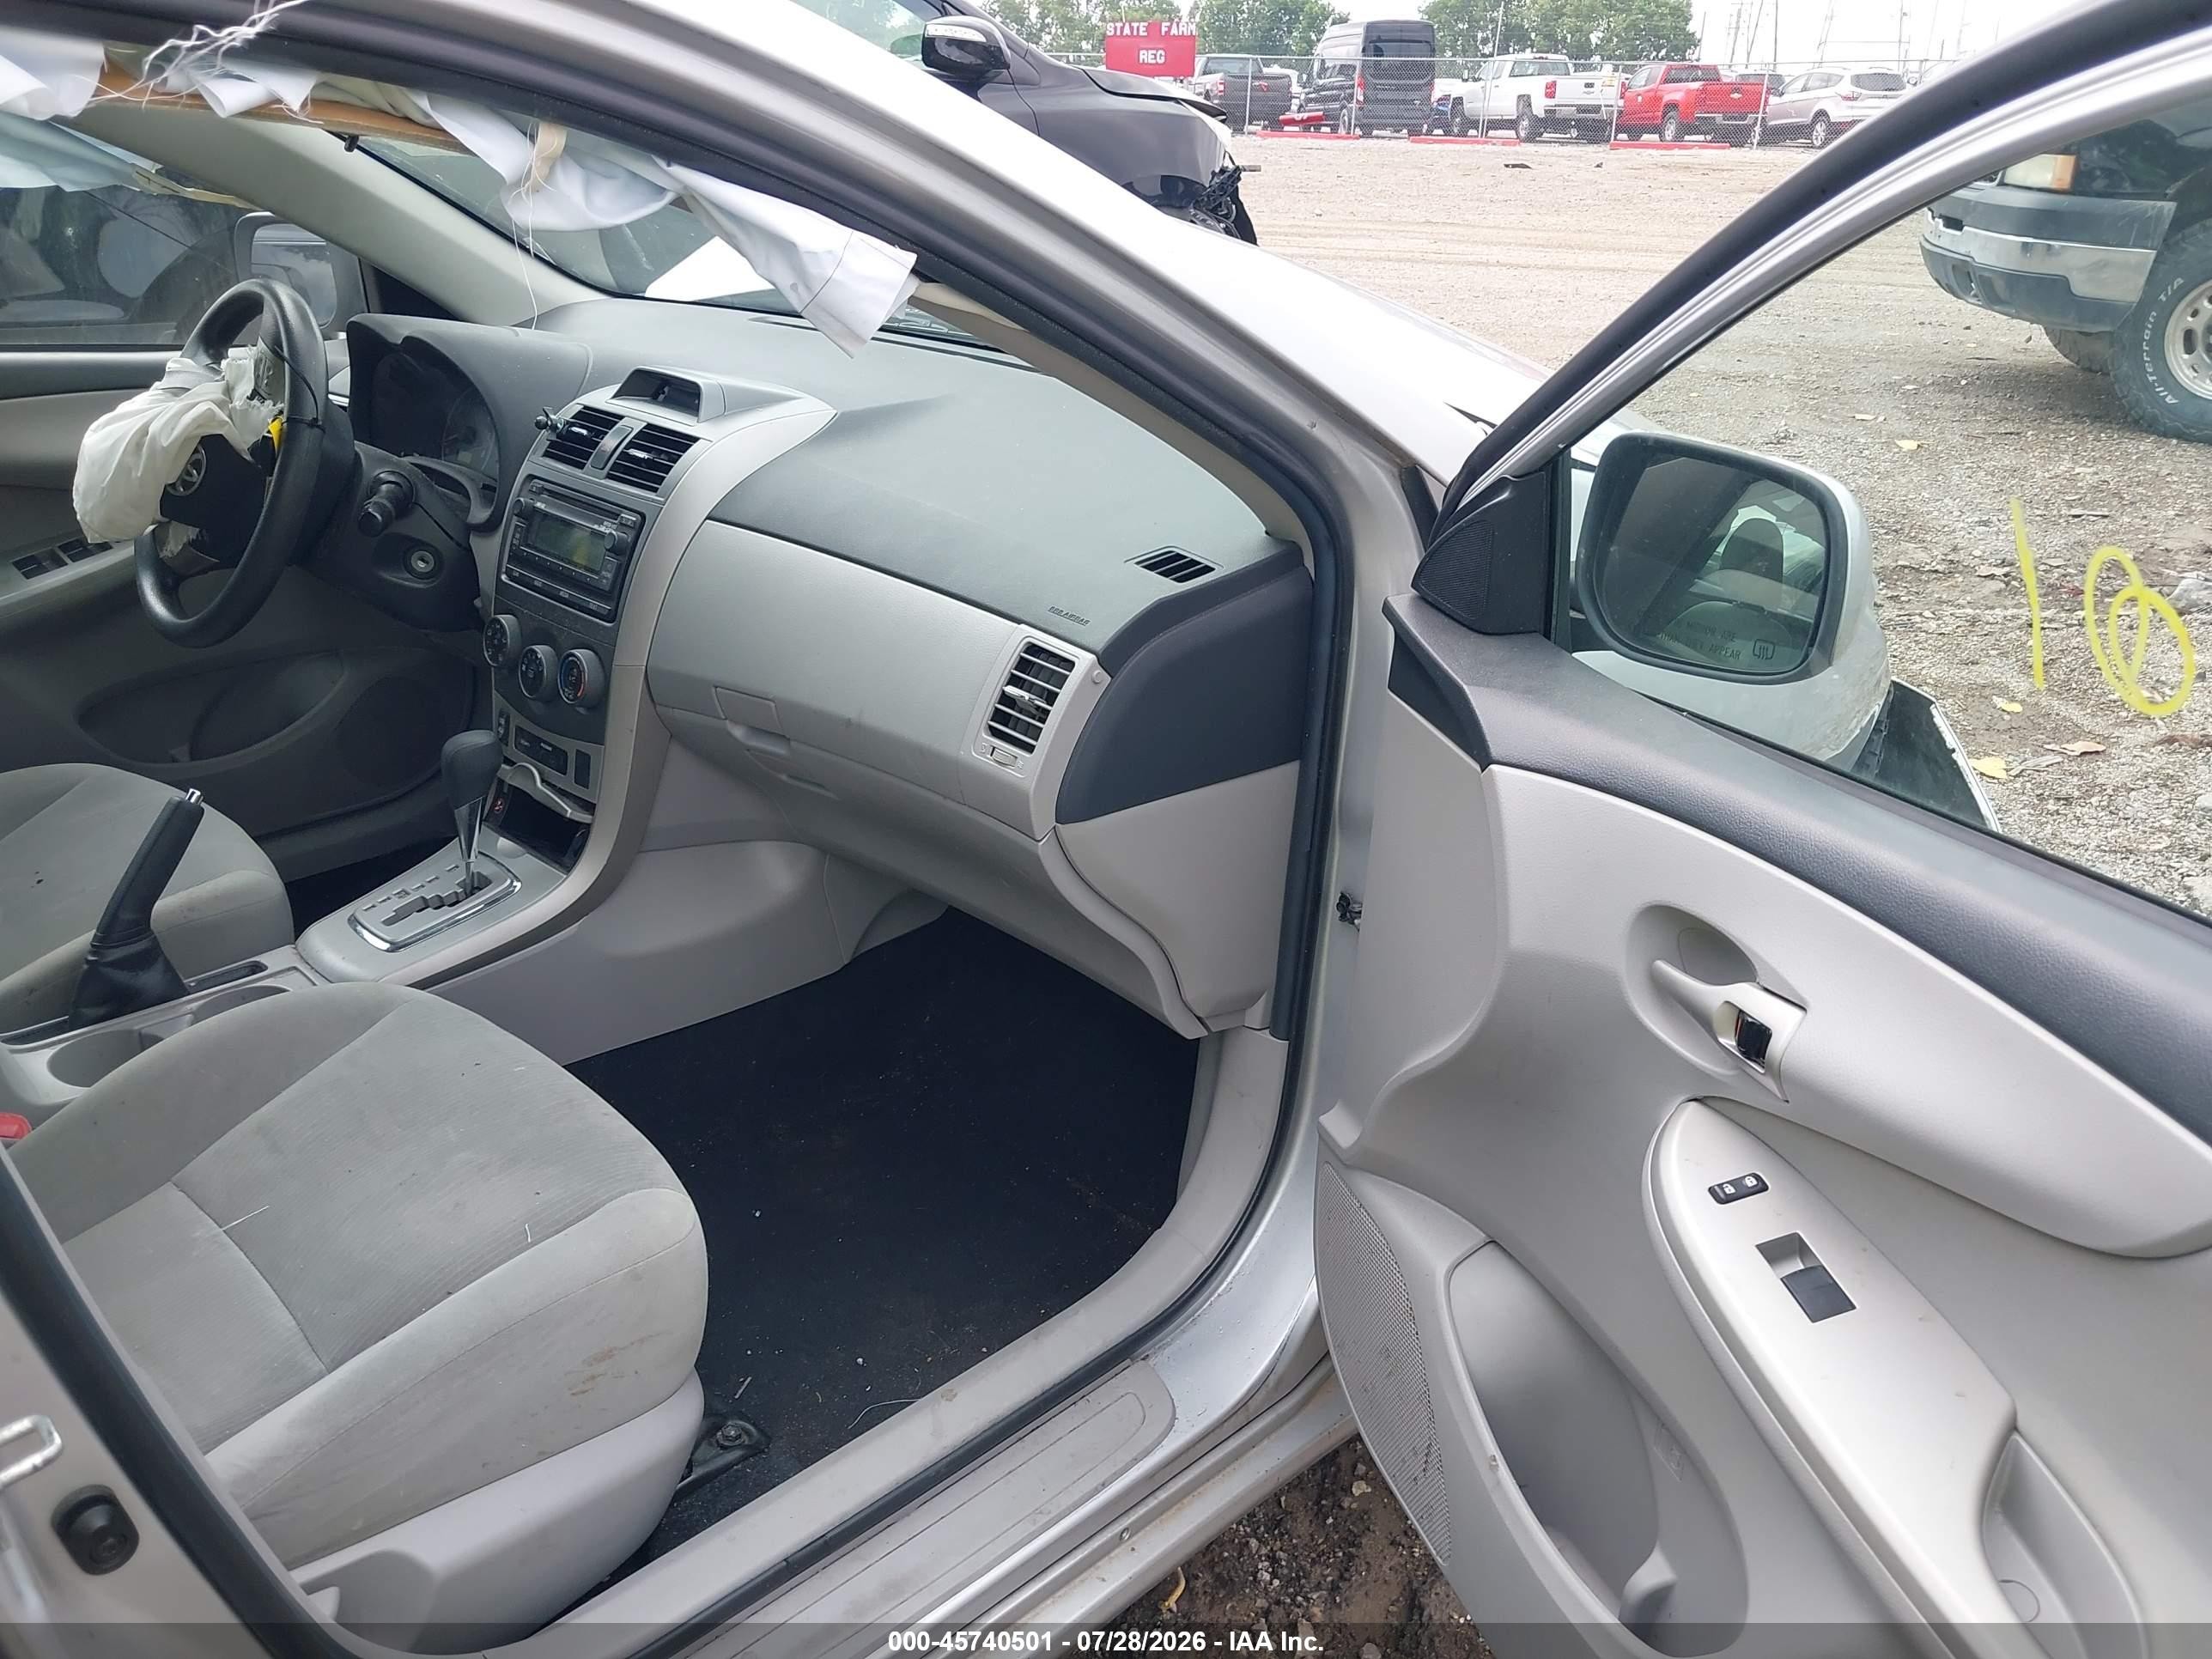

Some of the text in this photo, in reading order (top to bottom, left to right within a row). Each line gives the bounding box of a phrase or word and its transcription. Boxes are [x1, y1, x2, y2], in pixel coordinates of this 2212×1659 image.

[1107, 22, 1196, 36] STATE FARM
[1139, 50, 1165, 64] REG
